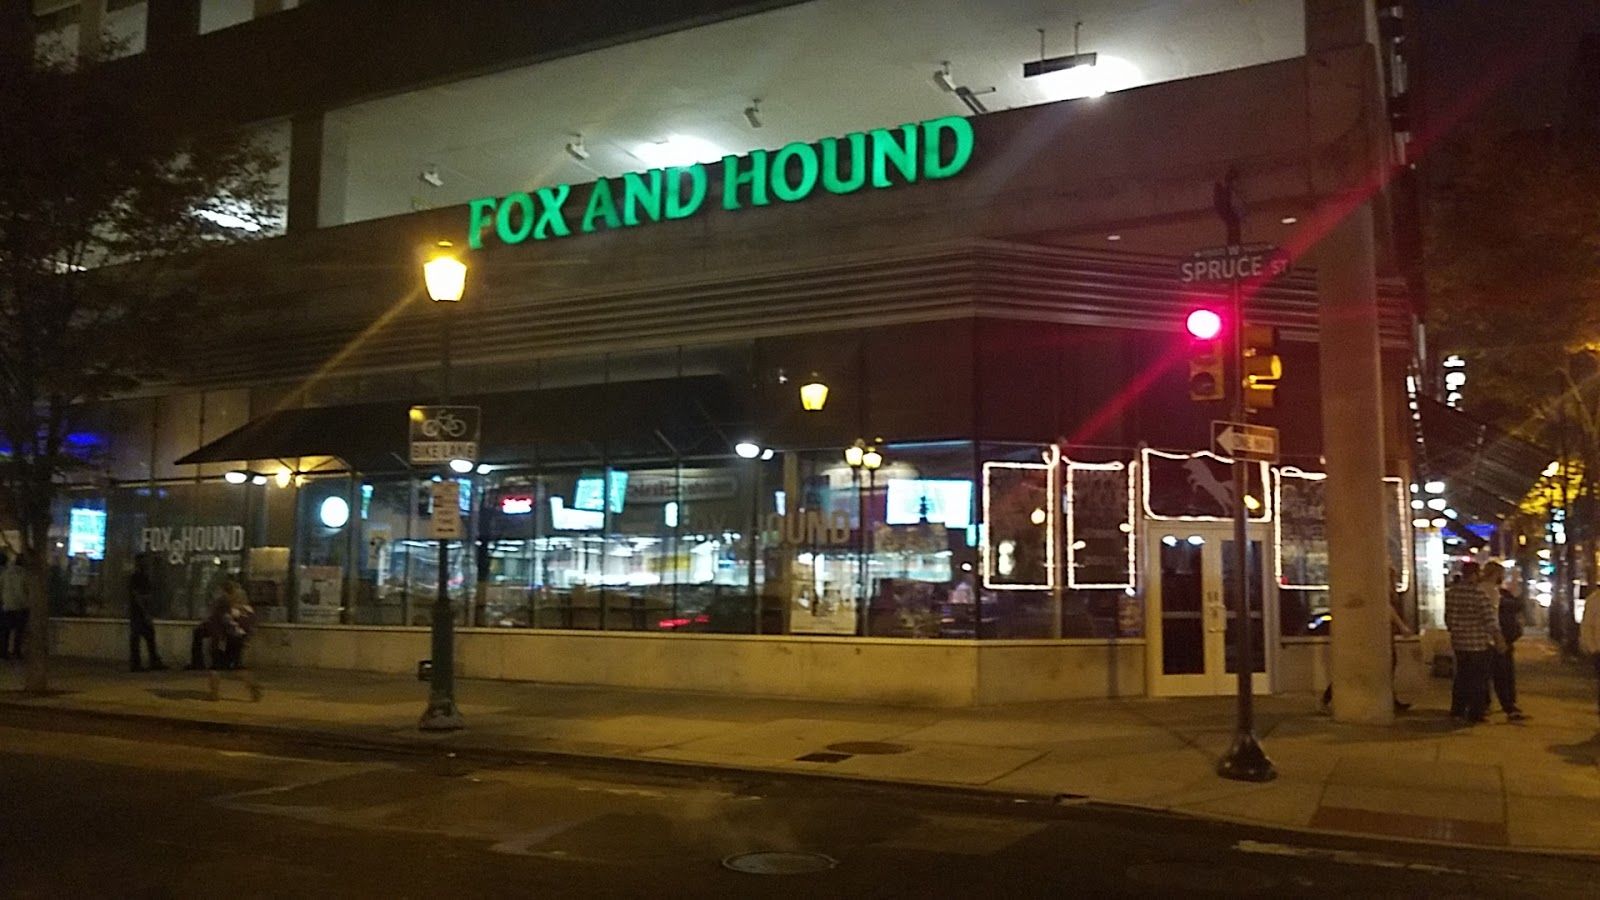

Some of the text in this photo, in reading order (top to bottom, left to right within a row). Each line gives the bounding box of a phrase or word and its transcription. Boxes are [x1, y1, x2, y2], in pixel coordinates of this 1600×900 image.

[468, 115, 974, 249] FOX AND HOUND
[1181, 255, 1289, 283] SPRUCE ST
[412, 445, 438, 459] BIKE
[141, 527, 172, 552] FOX
[181, 525, 245, 552] HOUND
